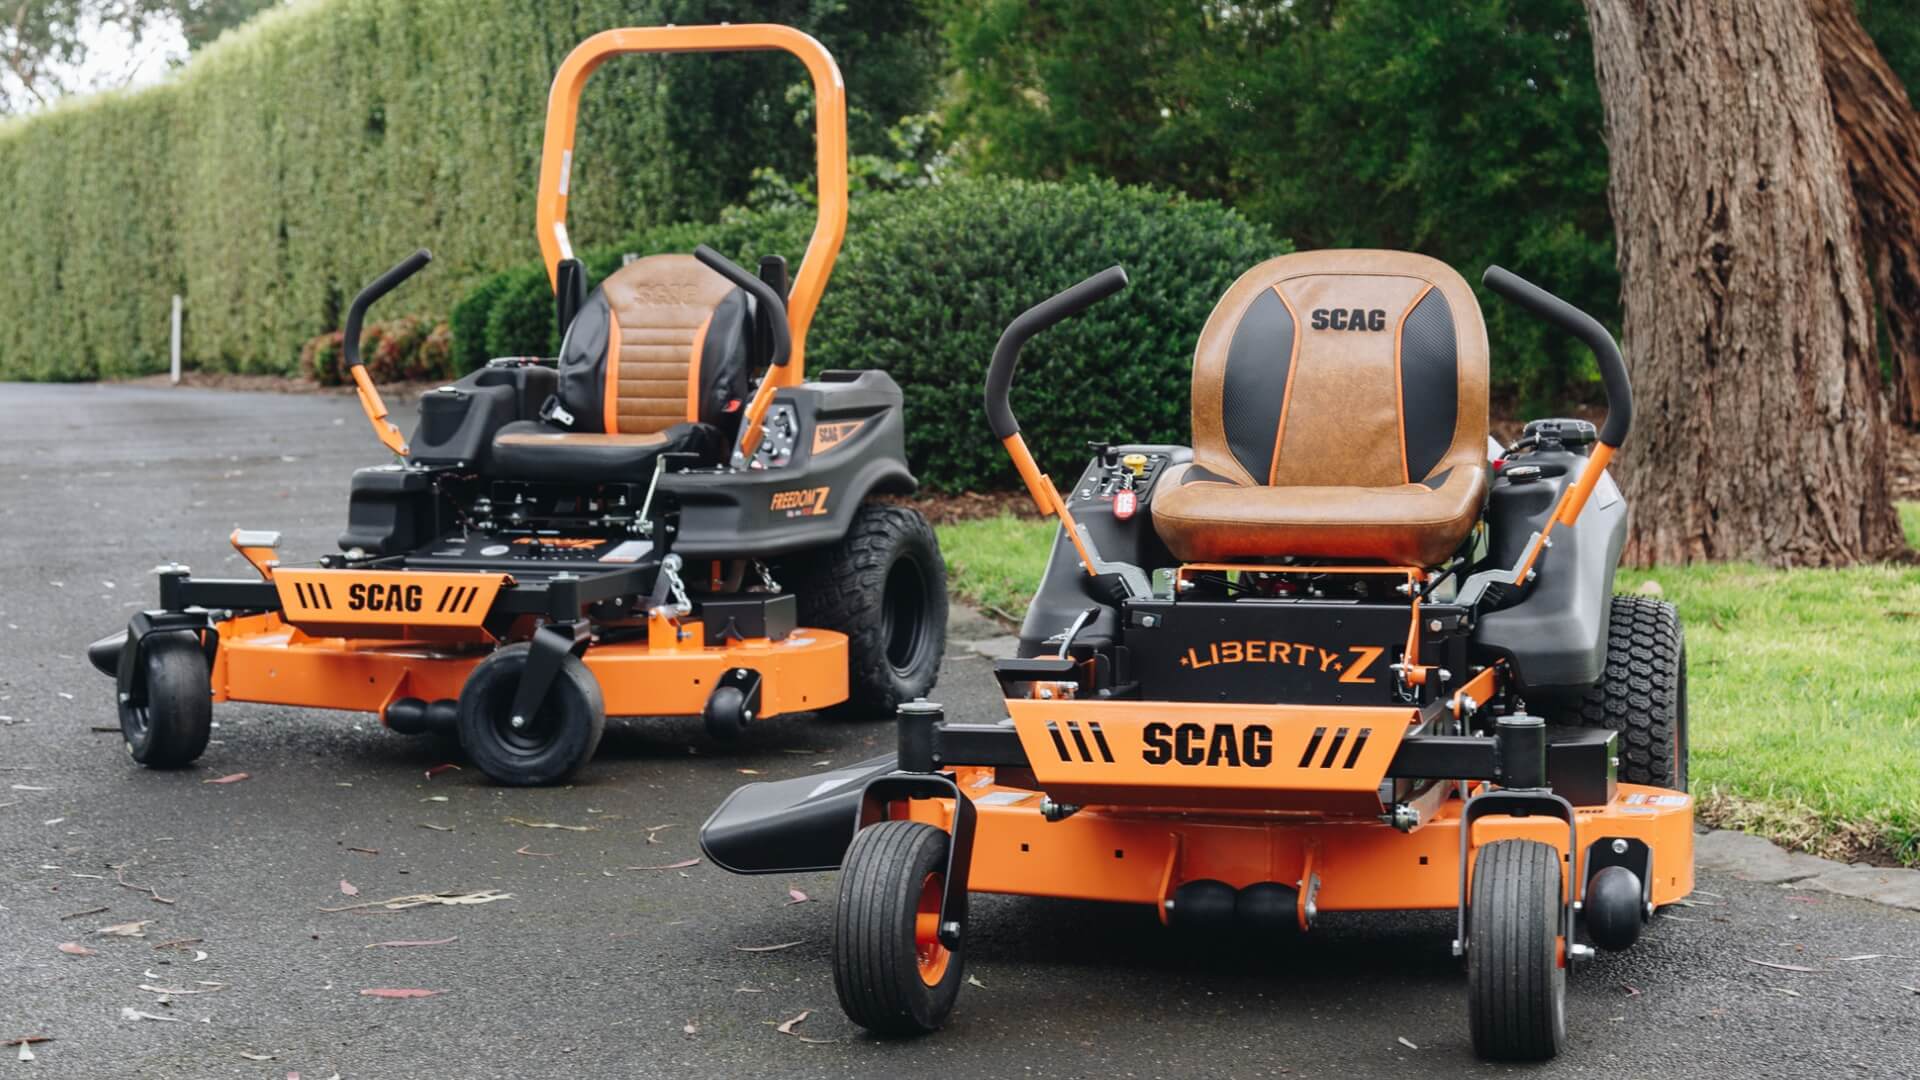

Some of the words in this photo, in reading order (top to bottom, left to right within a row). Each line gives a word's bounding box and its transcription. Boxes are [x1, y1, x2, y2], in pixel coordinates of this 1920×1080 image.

[1311, 308, 1386, 332] SCAG
[770, 489, 816, 511] FREEDOM
[348, 583, 422, 612] SCAG
[1188, 640, 1339, 672] LIBERTY
[1338, 646, 1385, 683] Z
[1143, 722, 1273, 768] SCAG
